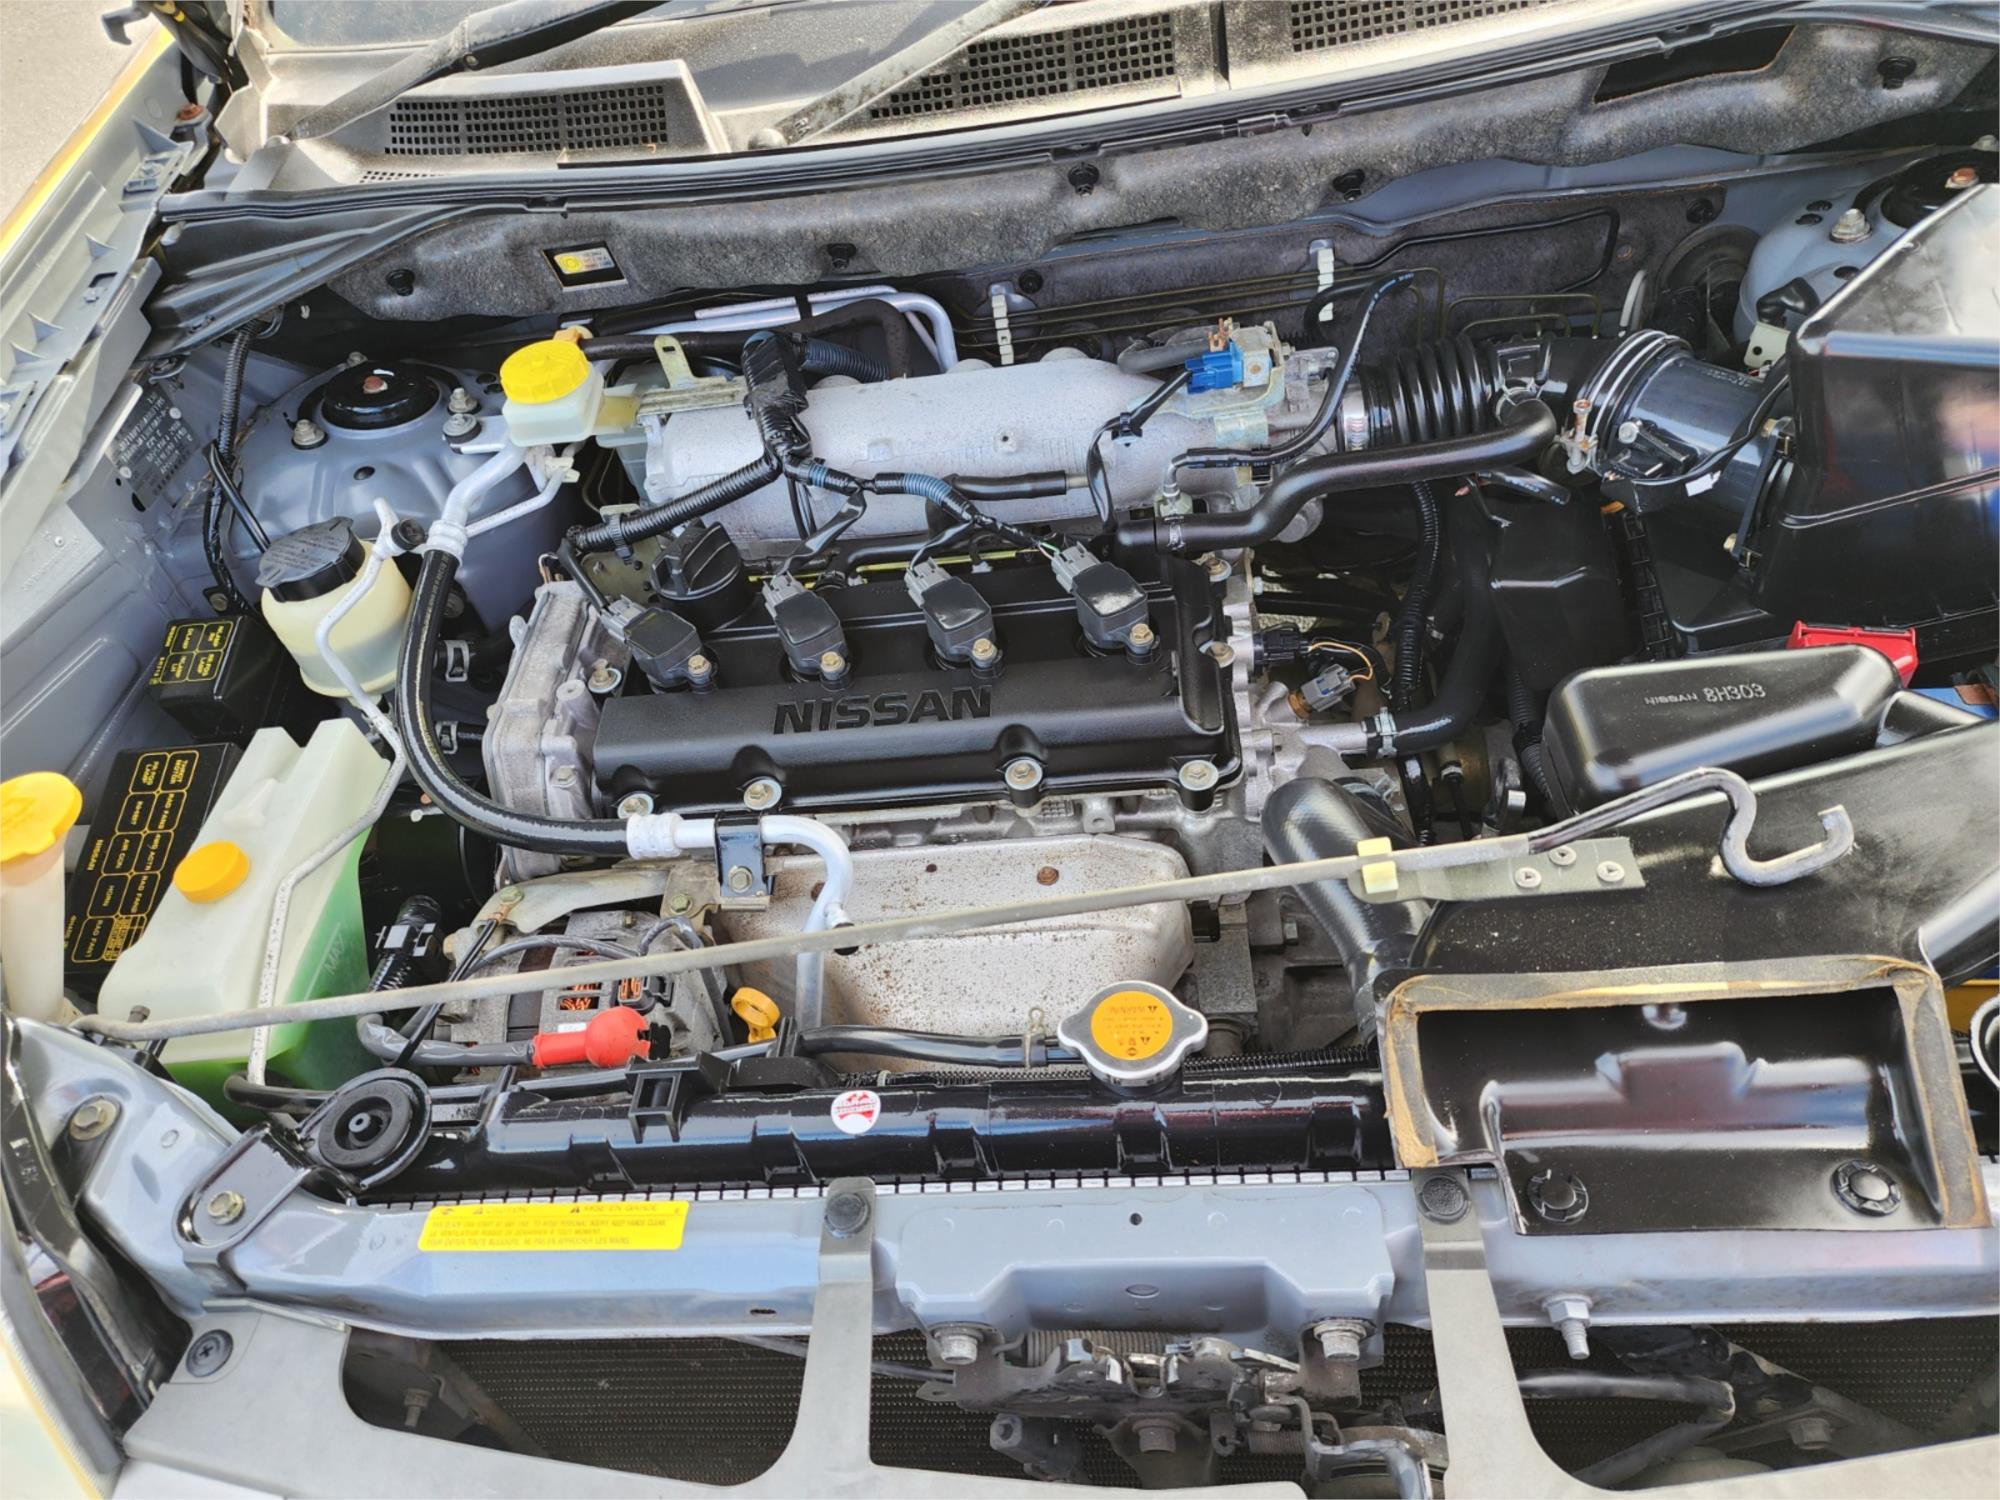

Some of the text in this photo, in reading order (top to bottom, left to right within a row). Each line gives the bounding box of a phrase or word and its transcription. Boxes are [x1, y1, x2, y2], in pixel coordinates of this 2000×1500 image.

[1644, 683, 1766, 705] NISSAN 8H303
[773, 685, 992, 735] NISSAN
[87, 839, 104, 870] NISSAN
[102, 884, 115, 907] HORN
